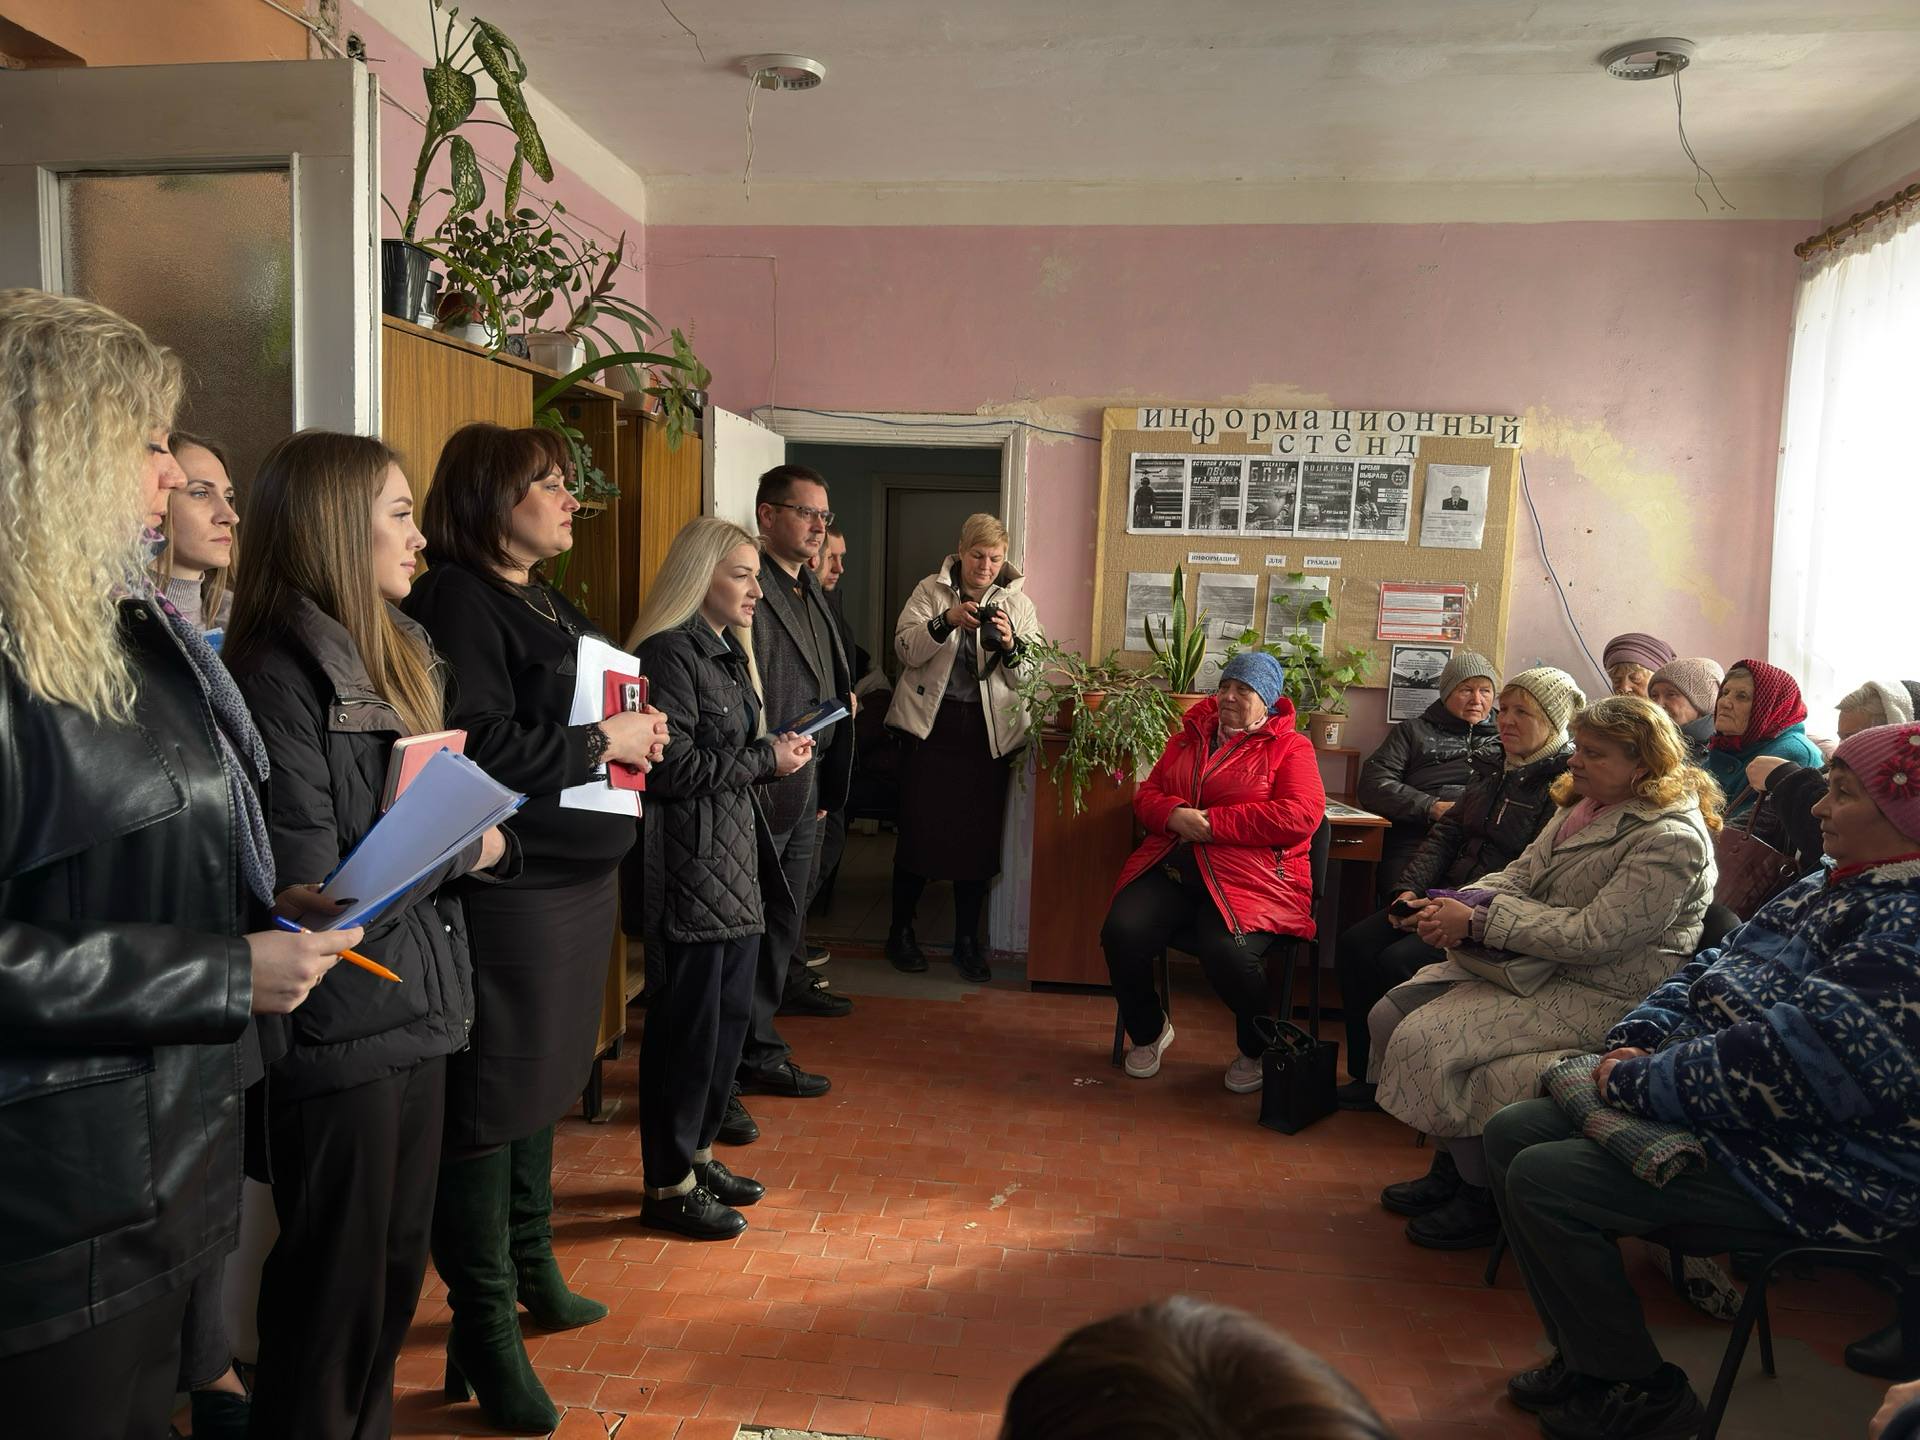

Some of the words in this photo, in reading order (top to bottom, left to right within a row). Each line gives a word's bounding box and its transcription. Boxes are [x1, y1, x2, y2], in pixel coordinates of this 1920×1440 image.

[1143, 408, 1521, 445] информационный
[1278, 433, 1416, 459] стенд
[1206, 466, 1226, 477] ПВО
[1304, 464, 1353, 473] ВОДИТЕЛЬ
[1360, 464, 1381, 472] ВРЕМЯ
[1250, 466, 1297, 483] БПЛА
[1359, 472, 1389, 480] ВЫБРАЛО
[1358, 480, 1372, 488] НАС
[1191, 554, 1238, 563] ИНФОРМАЦИЯ
[1268, 557, 1283, 565] ДЛЯ
[1306, 558, 1338, 567] ГРАЖДАН
